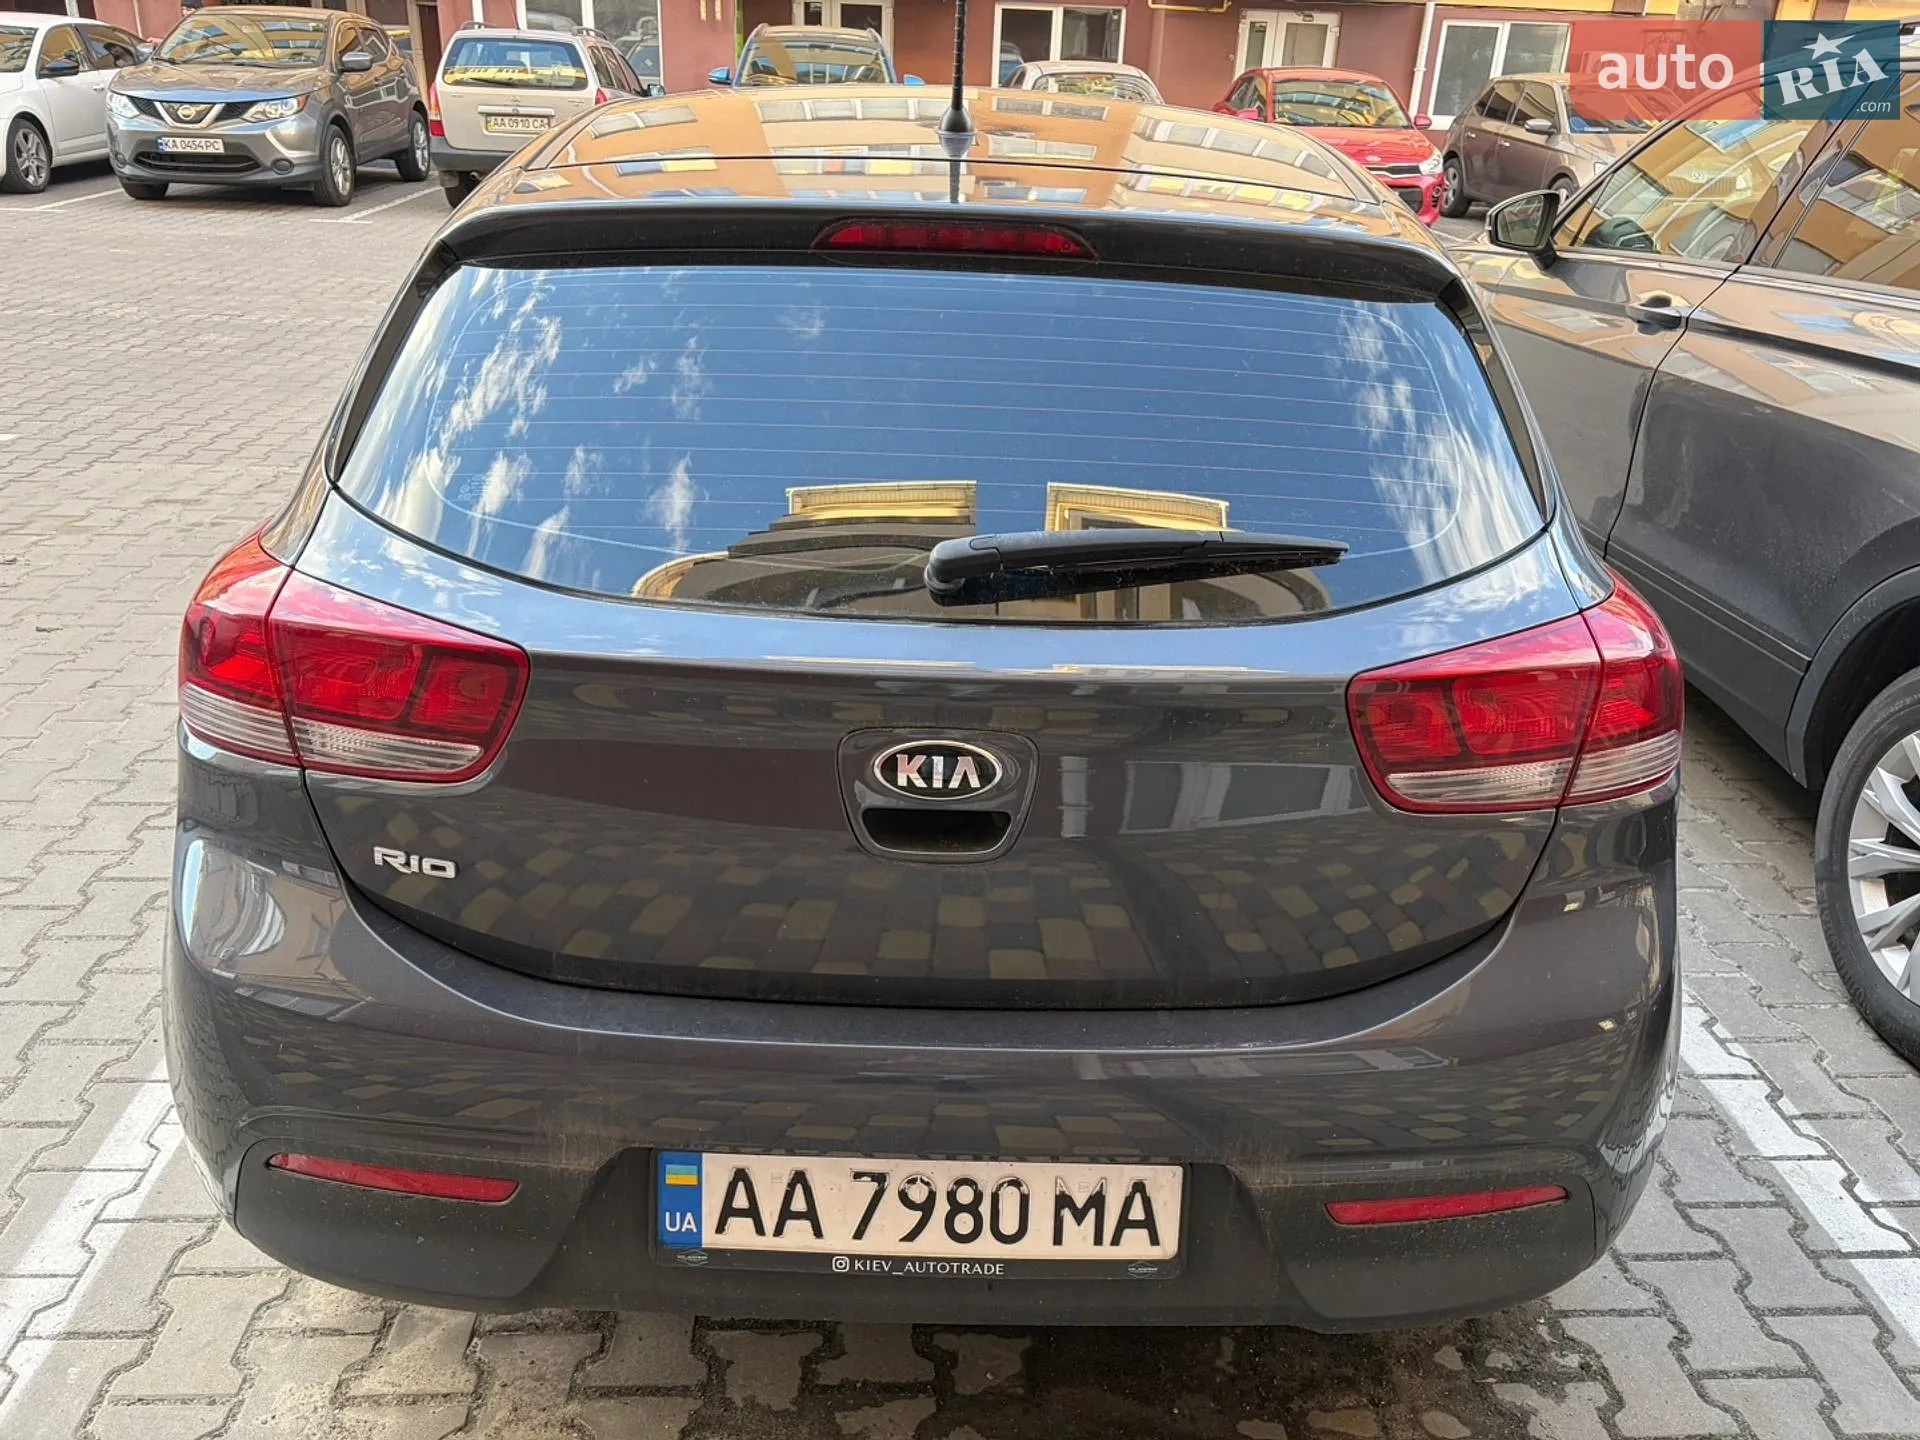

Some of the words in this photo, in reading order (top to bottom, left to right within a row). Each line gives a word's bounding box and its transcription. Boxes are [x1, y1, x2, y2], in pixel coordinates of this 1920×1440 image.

[493, 117, 507, 128] AA
[508, 118, 531, 129] 0910
[532, 119, 547, 129] CA
[164, 138, 179, 150] KA
[180, 139, 204, 151] 0454
[204, 140, 221, 151] PC
[895, 753, 982, 790] KIA
[373, 846, 456, 879] RIO
[714, 1167, 824, 1240] AA
[850, 1168, 1031, 1246] 7980
[1053, 1175, 1161, 1247] MA
[664, 1211, 698, 1233] UA
[854, 1259, 1005, 1276] KIEV_AUTOTRADE
